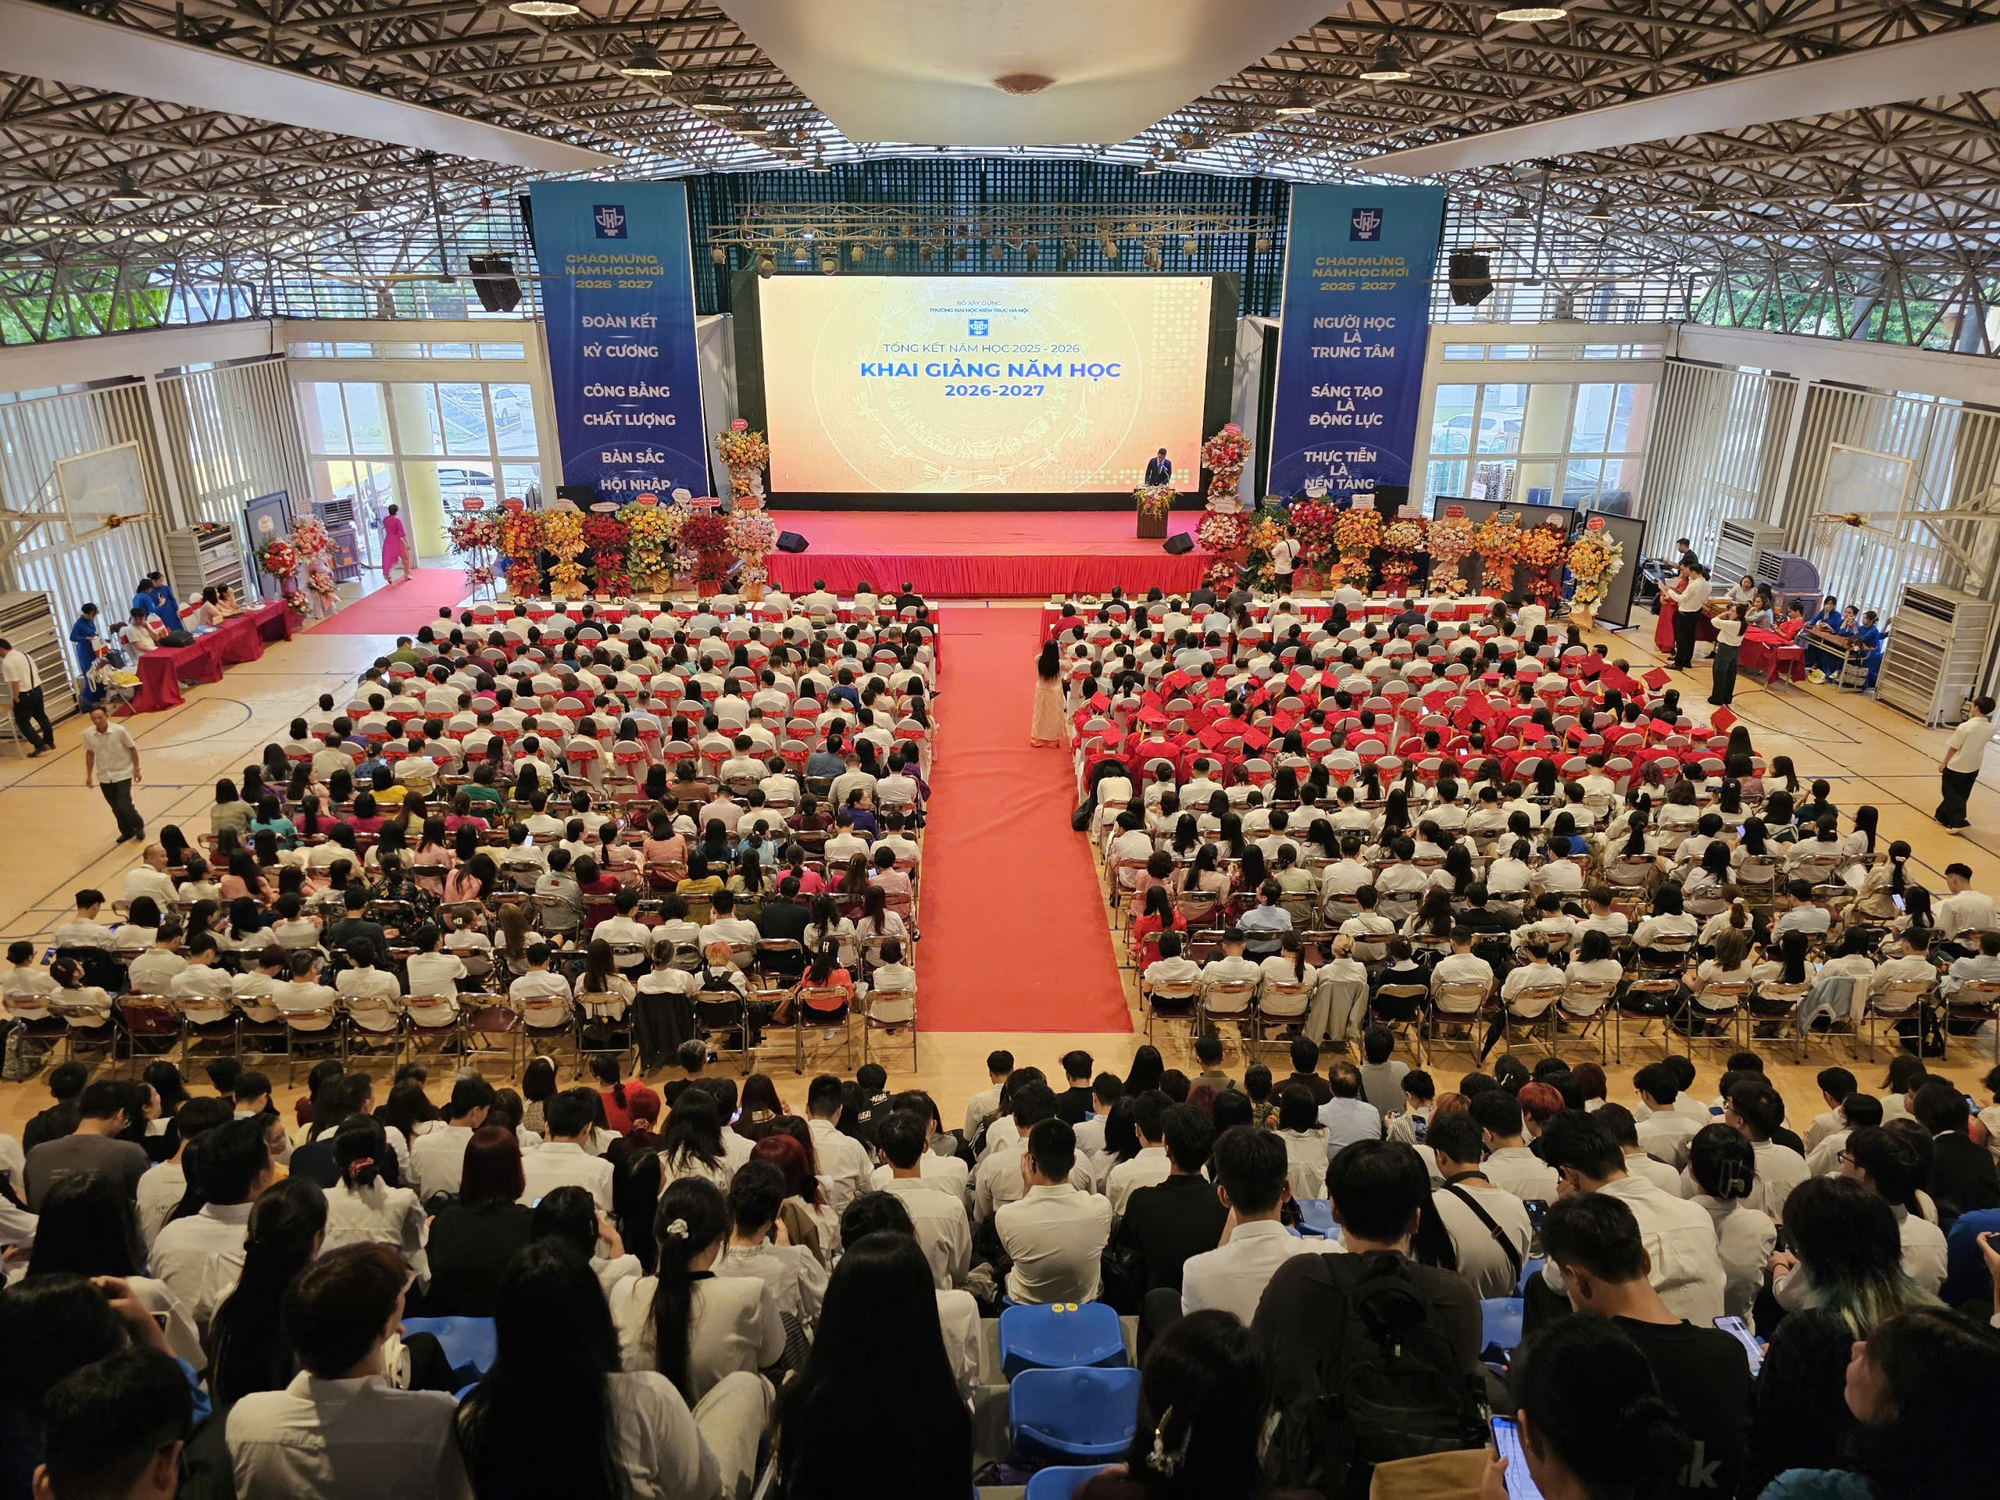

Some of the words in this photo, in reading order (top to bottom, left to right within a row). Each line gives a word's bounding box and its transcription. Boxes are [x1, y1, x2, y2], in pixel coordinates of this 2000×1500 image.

[575, 280, 613, 289] 2026
[618, 280, 654, 289] 2027
[1320, 282, 1356, 291] 2026
[1360, 281, 1397, 291] 2027
[581, 312, 628, 328] ĐOÀN
[629, 312, 659, 328] KẾT
[1312, 314, 1361, 329] NGƯỜI
[1363, 316, 1397, 332] HỌC
[1343, 328, 1363, 344] LÀ
[583, 341, 603, 357] KỶ
[605, 343, 659, 358] CƯƠNG
[922, 341, 946, 353] KẾT
[949, 342, 978, 353] NĂM
[981, 343, 1010, 355] HỌC
[1012, 344, 1041, 353] 2025
[1051, 344, 1080, 353] 2026
[1311, 346, 1361, 358] TRUNG
[1363, 343, 1396, 358] TÂM
[861, 362, 919, 378] KHAI
[925, 357, 1001, 378] GIẢNG
[1008, 359, 1063, 378] NĂM
[1069, 362, 1122, 382] HỌC
[583, 383, 626, 398] CÔNG
[628, 381, 671, 398] BẰNG
[944, 384, 1045, 397] 2026-2027
[1310, 383, 1352, 398] SÁNG
[1353, 385, 1384, 400] TẠO
[1336, 397, 1356, 412] LÀ
[583, 410, 623, 426] CHẤT
[625, 412, 677, 429] LƯỢNG
[1308, 411, 1353, 429] ĐỘNG
[1355, 413, 1384, 429] LỰC
[601, 448, 633, 464] BẢN
[635, 447, 665, 464] SẮC
[1303, 449, 1344, 466] THỰC
[1345, 446, 1378, 463] TIỄN
[1329, 462, 1349, 476] LÀ
[600, 477, 627, 494] HỘI
[630, 477, 672, 494] NHẬP
[1303, 475, 1334, 490] NỀN
[1336, 472, 1375, 490] TẢNG
